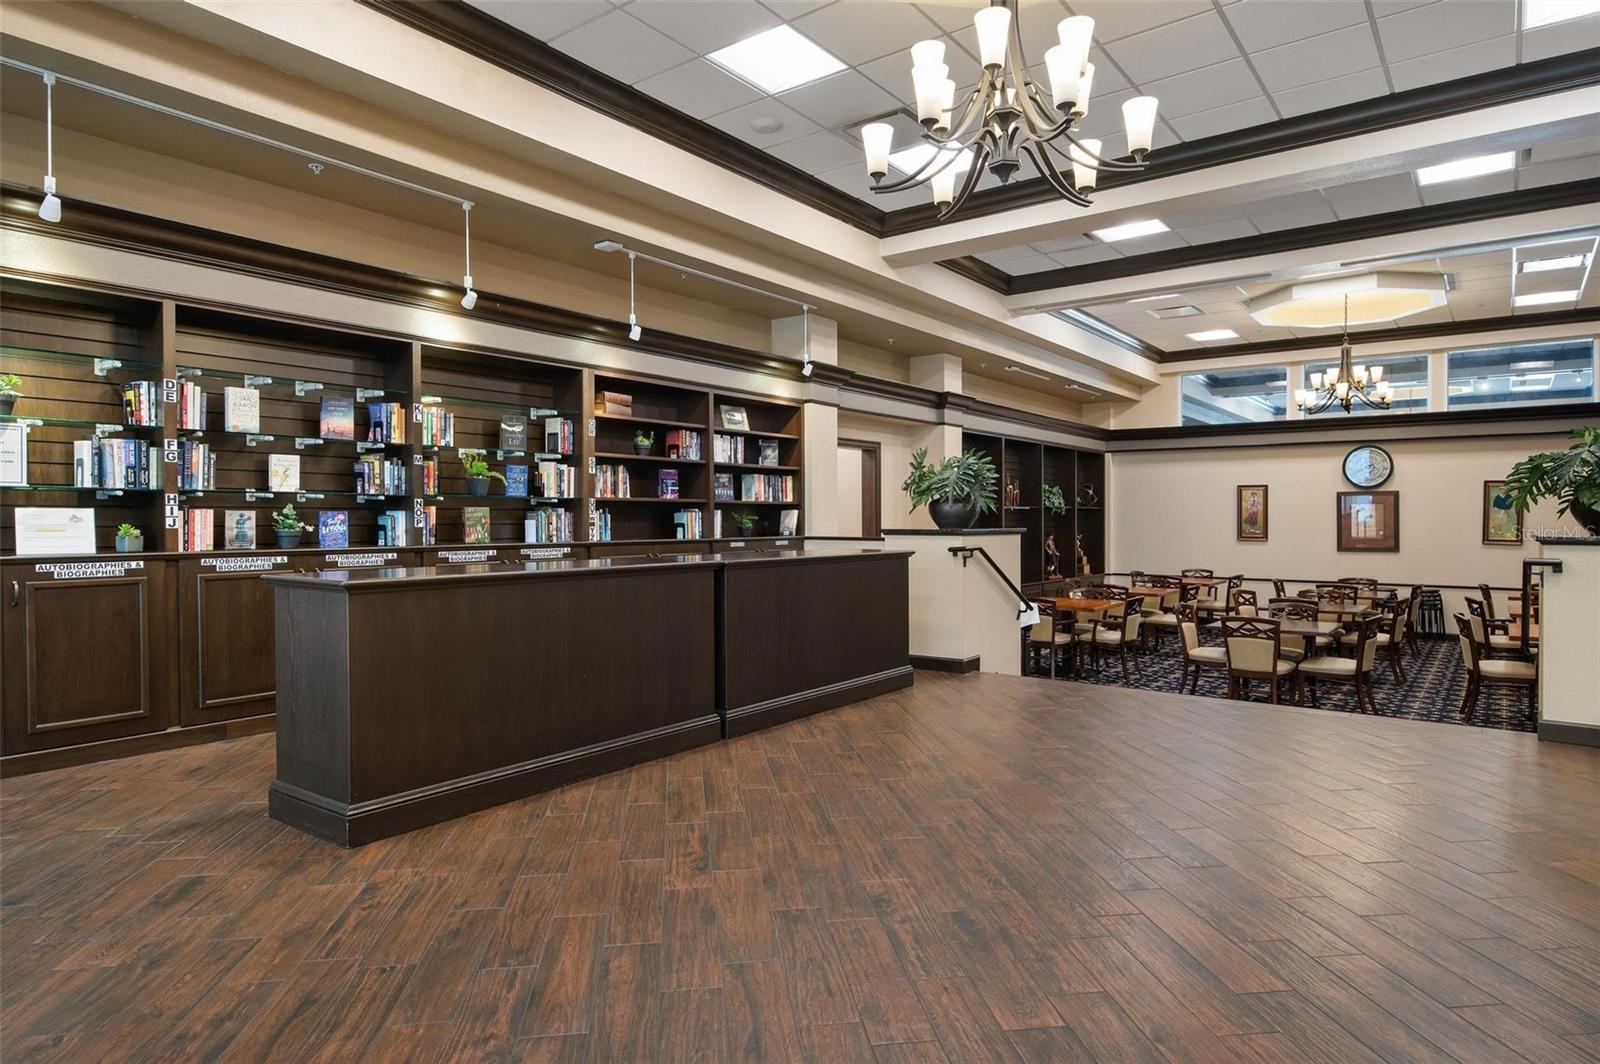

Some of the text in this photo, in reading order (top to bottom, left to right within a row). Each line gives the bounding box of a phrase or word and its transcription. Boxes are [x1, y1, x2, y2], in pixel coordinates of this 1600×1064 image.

[165, 380, 175, 390] D
[166, 392, 175, 401] E
[414, 413, 421, 421] L
[166, 441, 175, 449] F
[166, 451, 176, 461] G
[167, 494, 176, 504] H
[415, 500, 422, 508] N
[170, 507, 174, 516] I
[415, 509, 422, 517] O
[167, 518, 176, 527] J
[415, 518, 422, 526] P
[202, 557, 278, 565] AUTOBIOGRAPHIES
[37, 562, 133, 571] AUTOBIOGRAPHIES
[218, 563, 272, 571] BIOGRAPHIES
[56, 569, 124, 578] BIOGRAPHIES
